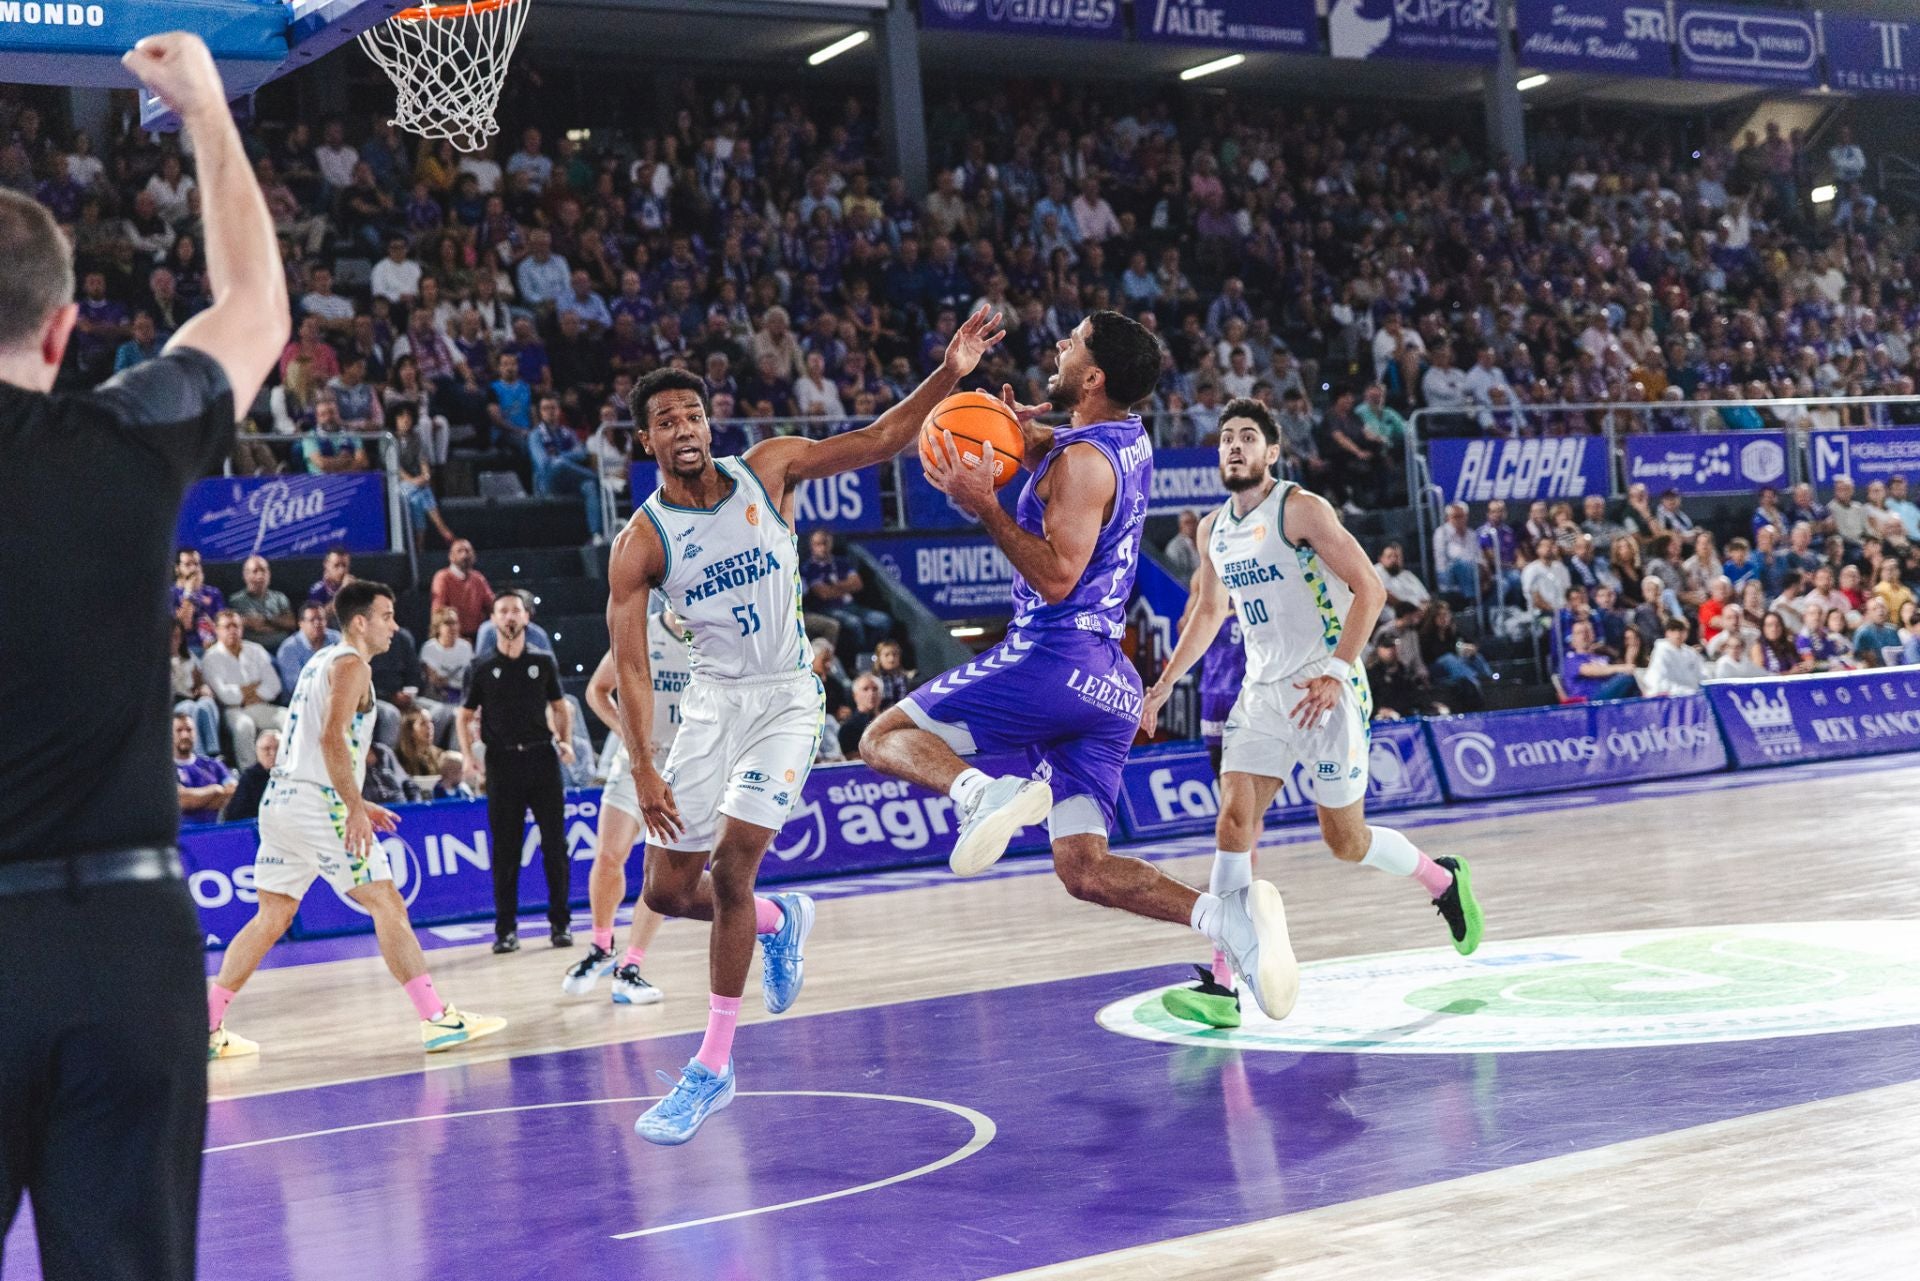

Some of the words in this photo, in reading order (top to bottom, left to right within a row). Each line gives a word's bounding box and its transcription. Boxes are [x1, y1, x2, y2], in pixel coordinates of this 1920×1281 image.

[0, 1, 104, 26] MONDO
[1455, 437, 1588, 500] ALCOPAL
[703, 547, 762, 579] HESTIA
[1224, 557, 1260, 573] HESTIA
[1243, 598, 1269, 626] 00
[1810, 681, 1918, 707] HOTEL
[1811, 716, 1859, 743] REY
[1504, 735, 1599, 767] ramos
[1607, 721, 1711, 762] ópticos
[828, 779, 912, 806] súper
